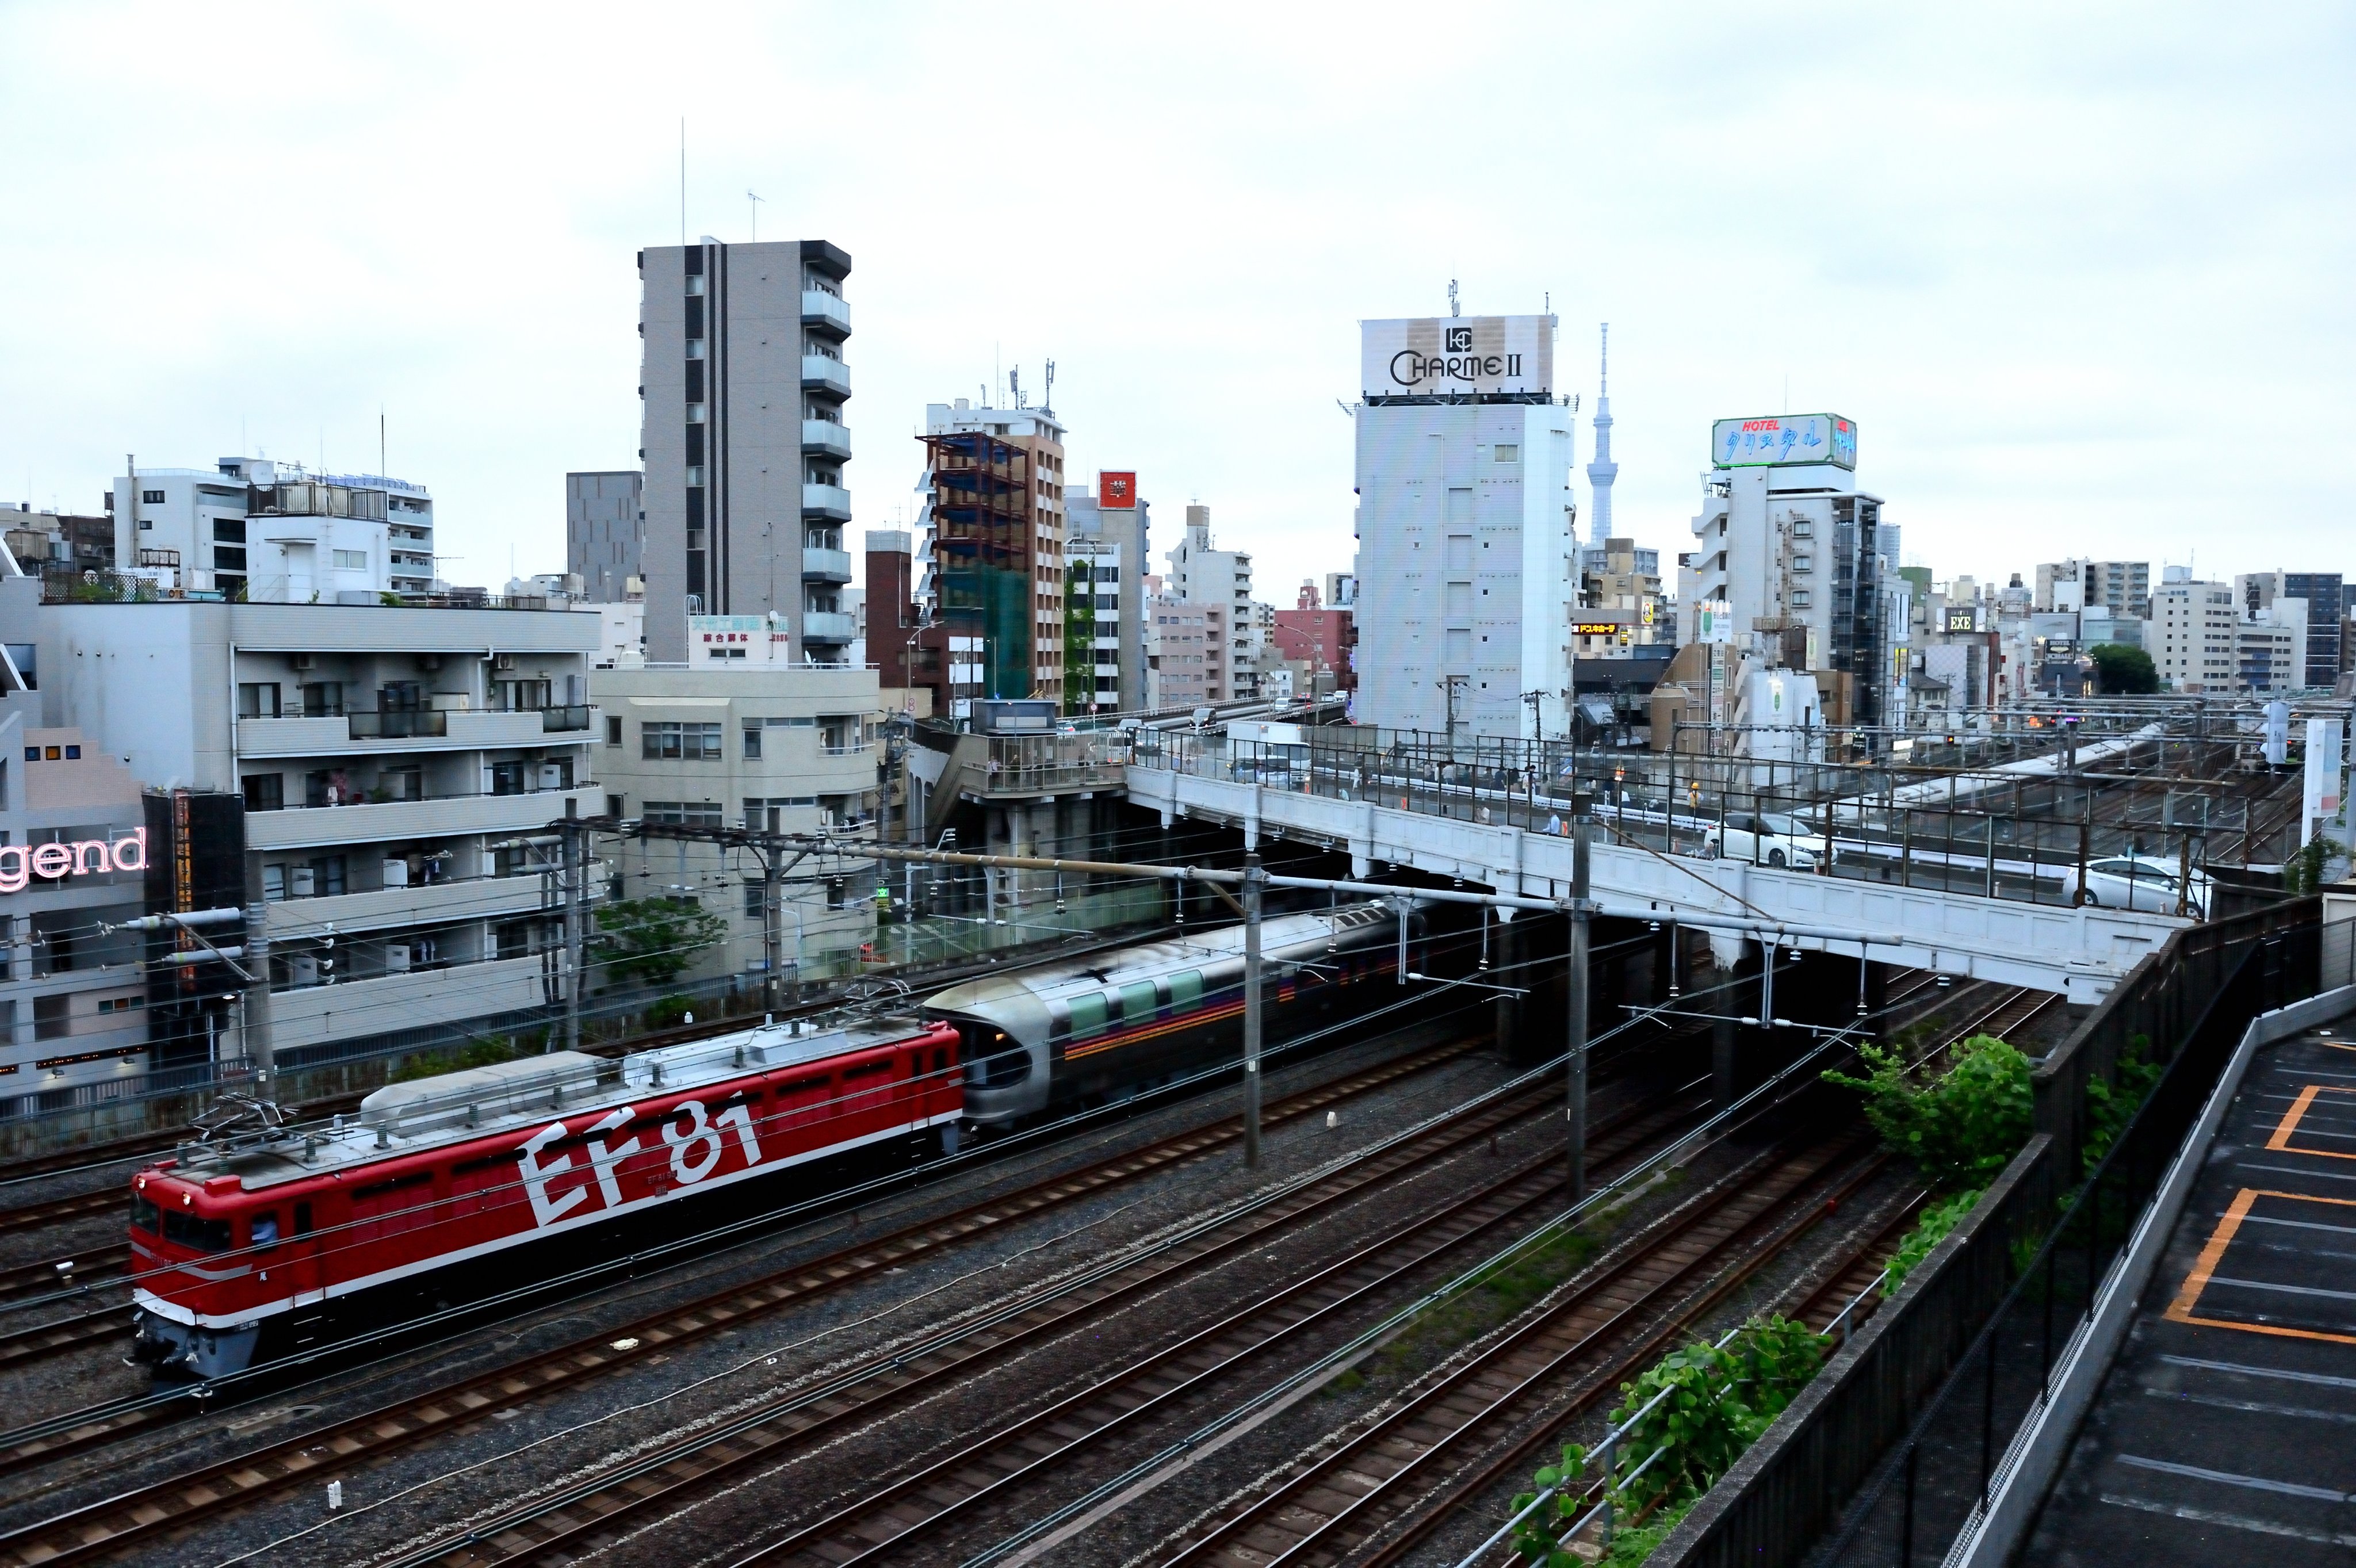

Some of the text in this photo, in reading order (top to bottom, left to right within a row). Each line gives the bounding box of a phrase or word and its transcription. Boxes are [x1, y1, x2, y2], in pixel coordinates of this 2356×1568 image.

[1390, 350, 1502, 386] CHARME
[1742, 420, 1780, 431] HOTEL
[1725, 420, 1821, 461] クリスタル
[1950, 616, 1971, 630] EXE
